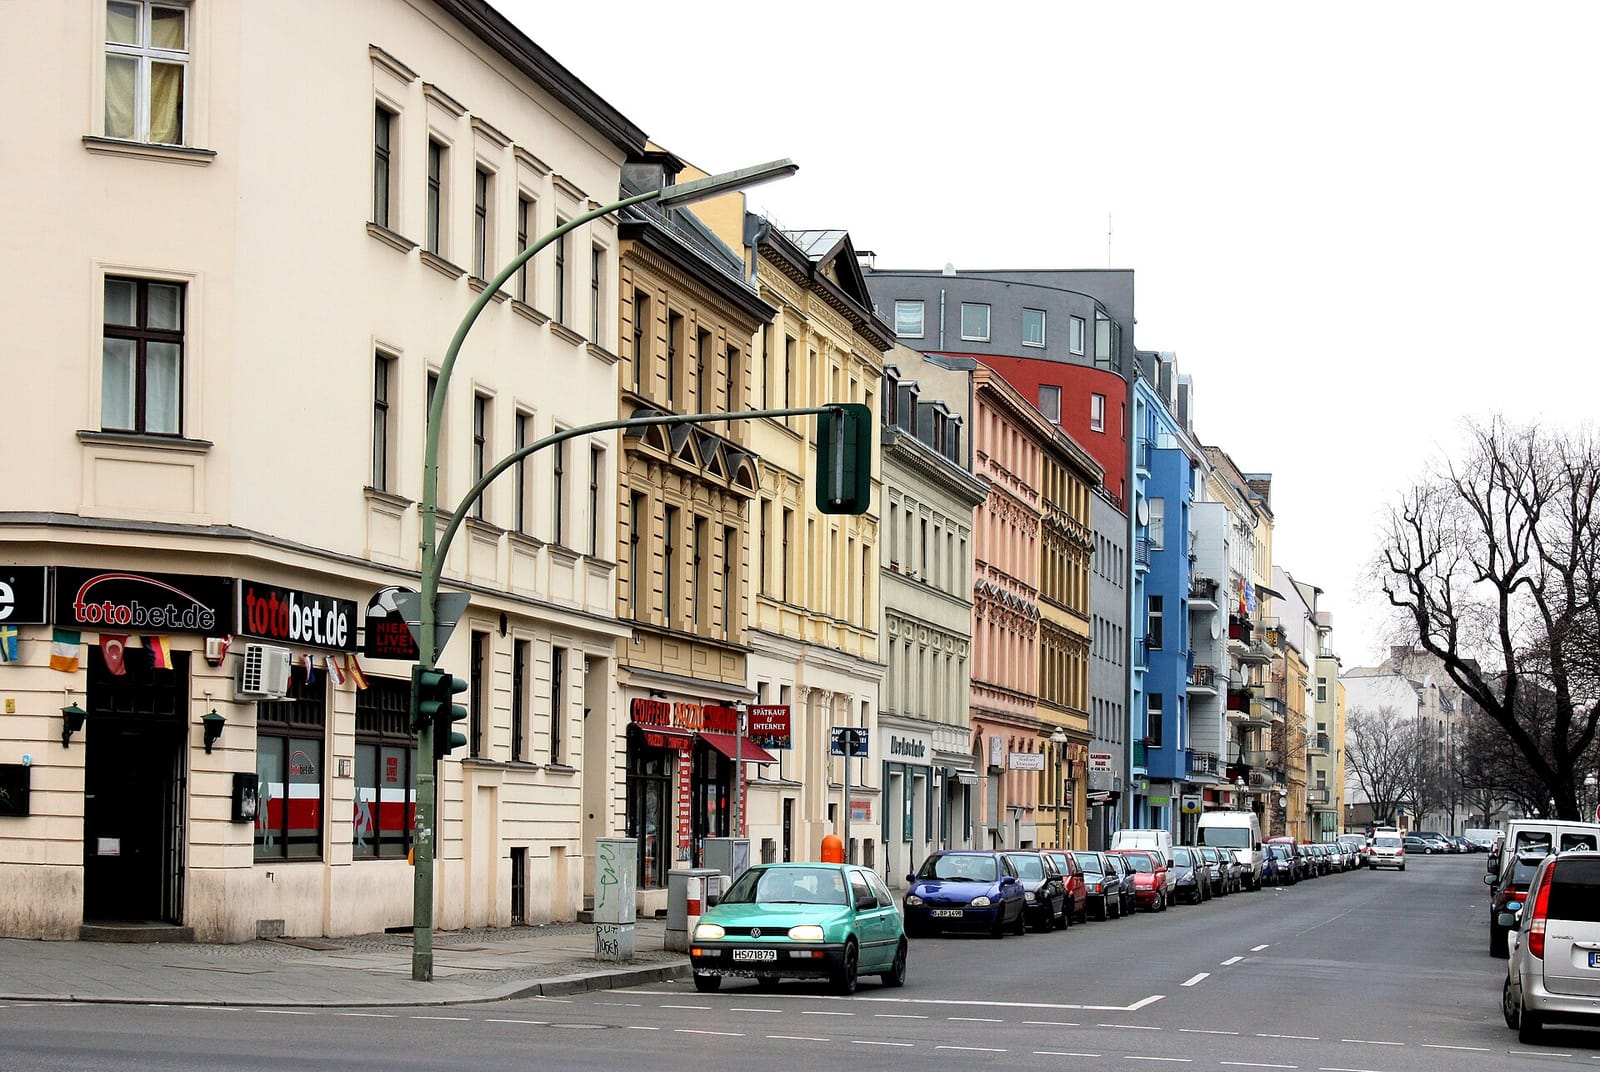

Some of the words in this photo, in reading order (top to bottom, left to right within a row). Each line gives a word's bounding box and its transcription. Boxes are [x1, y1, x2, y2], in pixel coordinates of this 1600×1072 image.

[73, 600, 215, 630] totobet.de
[246, 587, 348, 647] totobet.de
[633, 699, 671, 725] COIFFEUR
[752, 708, 786, 716] SPÄTKAUF
